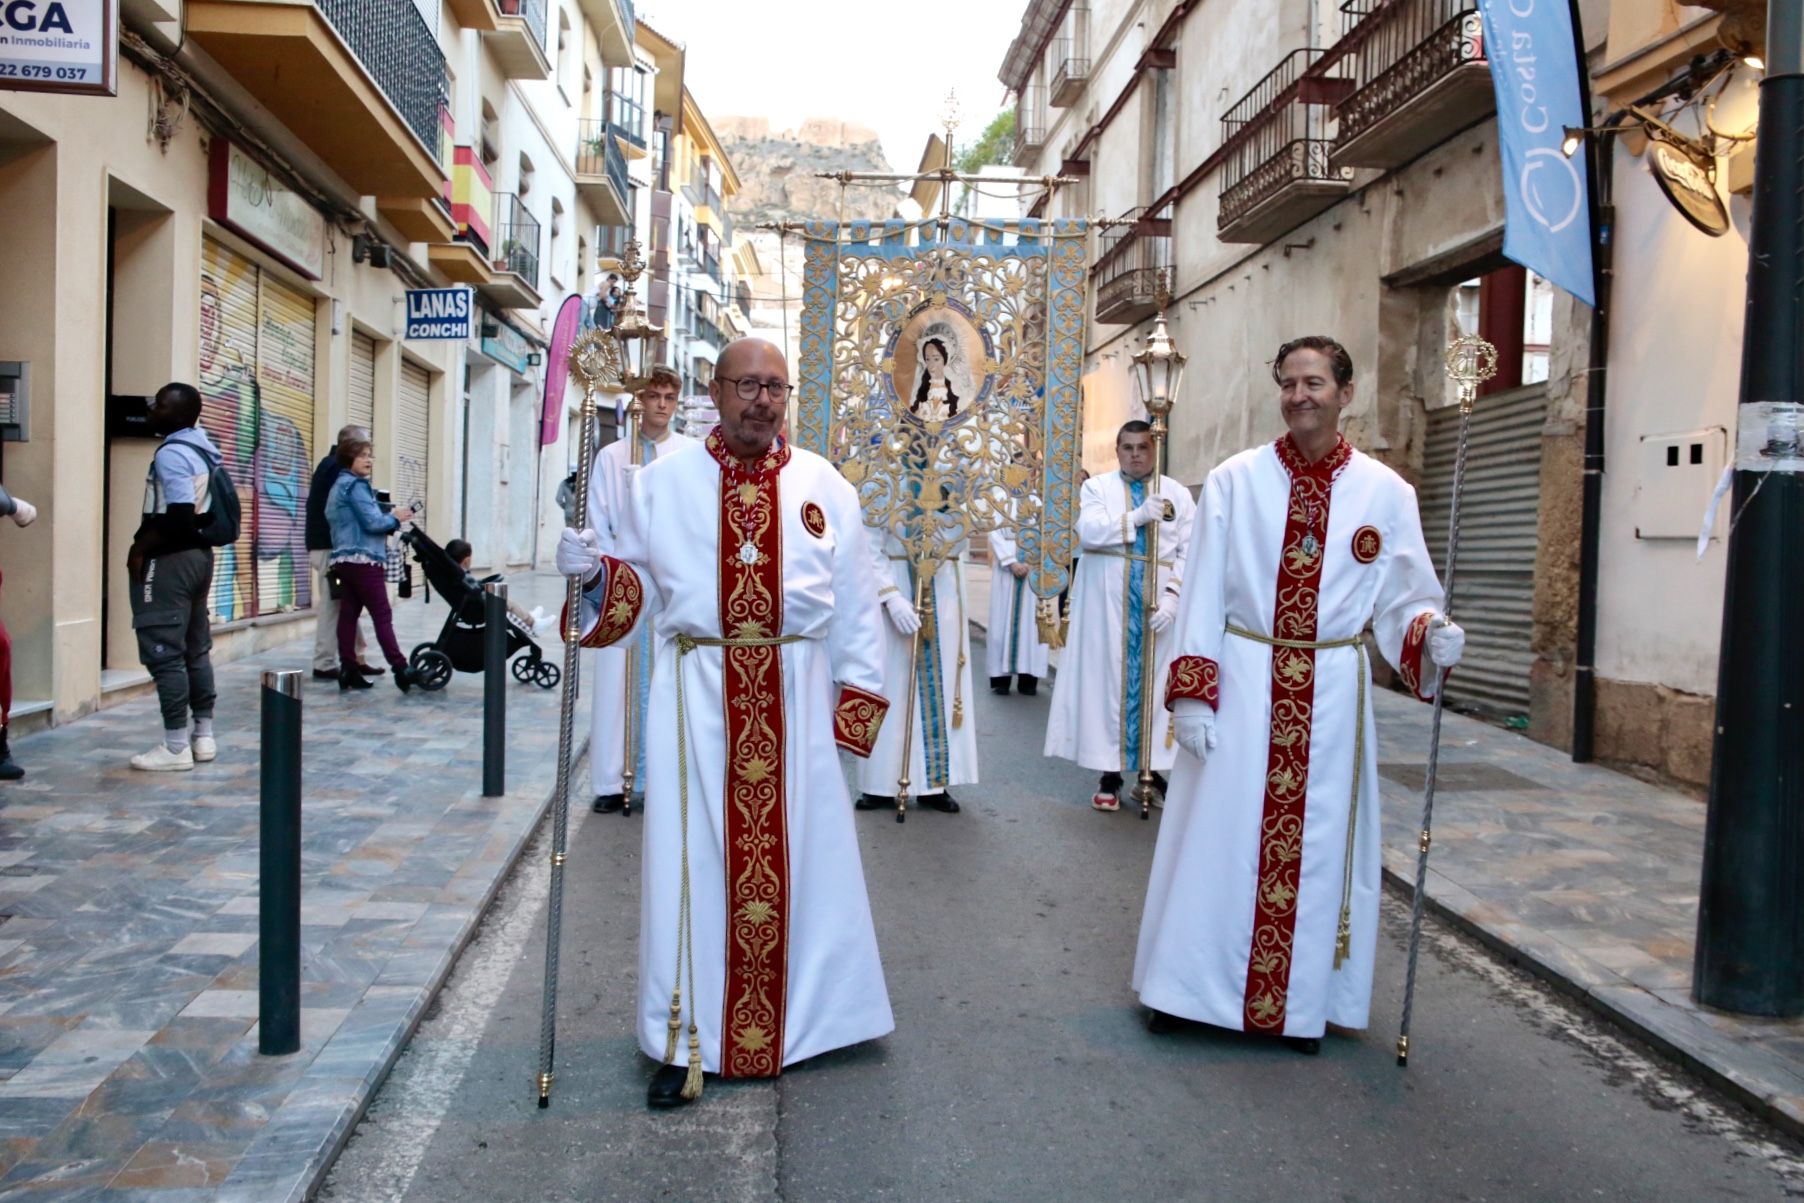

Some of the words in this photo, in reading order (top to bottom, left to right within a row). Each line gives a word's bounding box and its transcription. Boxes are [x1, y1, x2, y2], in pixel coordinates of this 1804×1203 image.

[0, 0, 73, 33] GA
[11, 36, 90, 49] Inmobiliaria
[21, 65, 51, 78] 679
[56, 67, 87, 80] 037
[409, 292, 467, 319] LANAS
[409, 322, 467, 337] CONCHI
